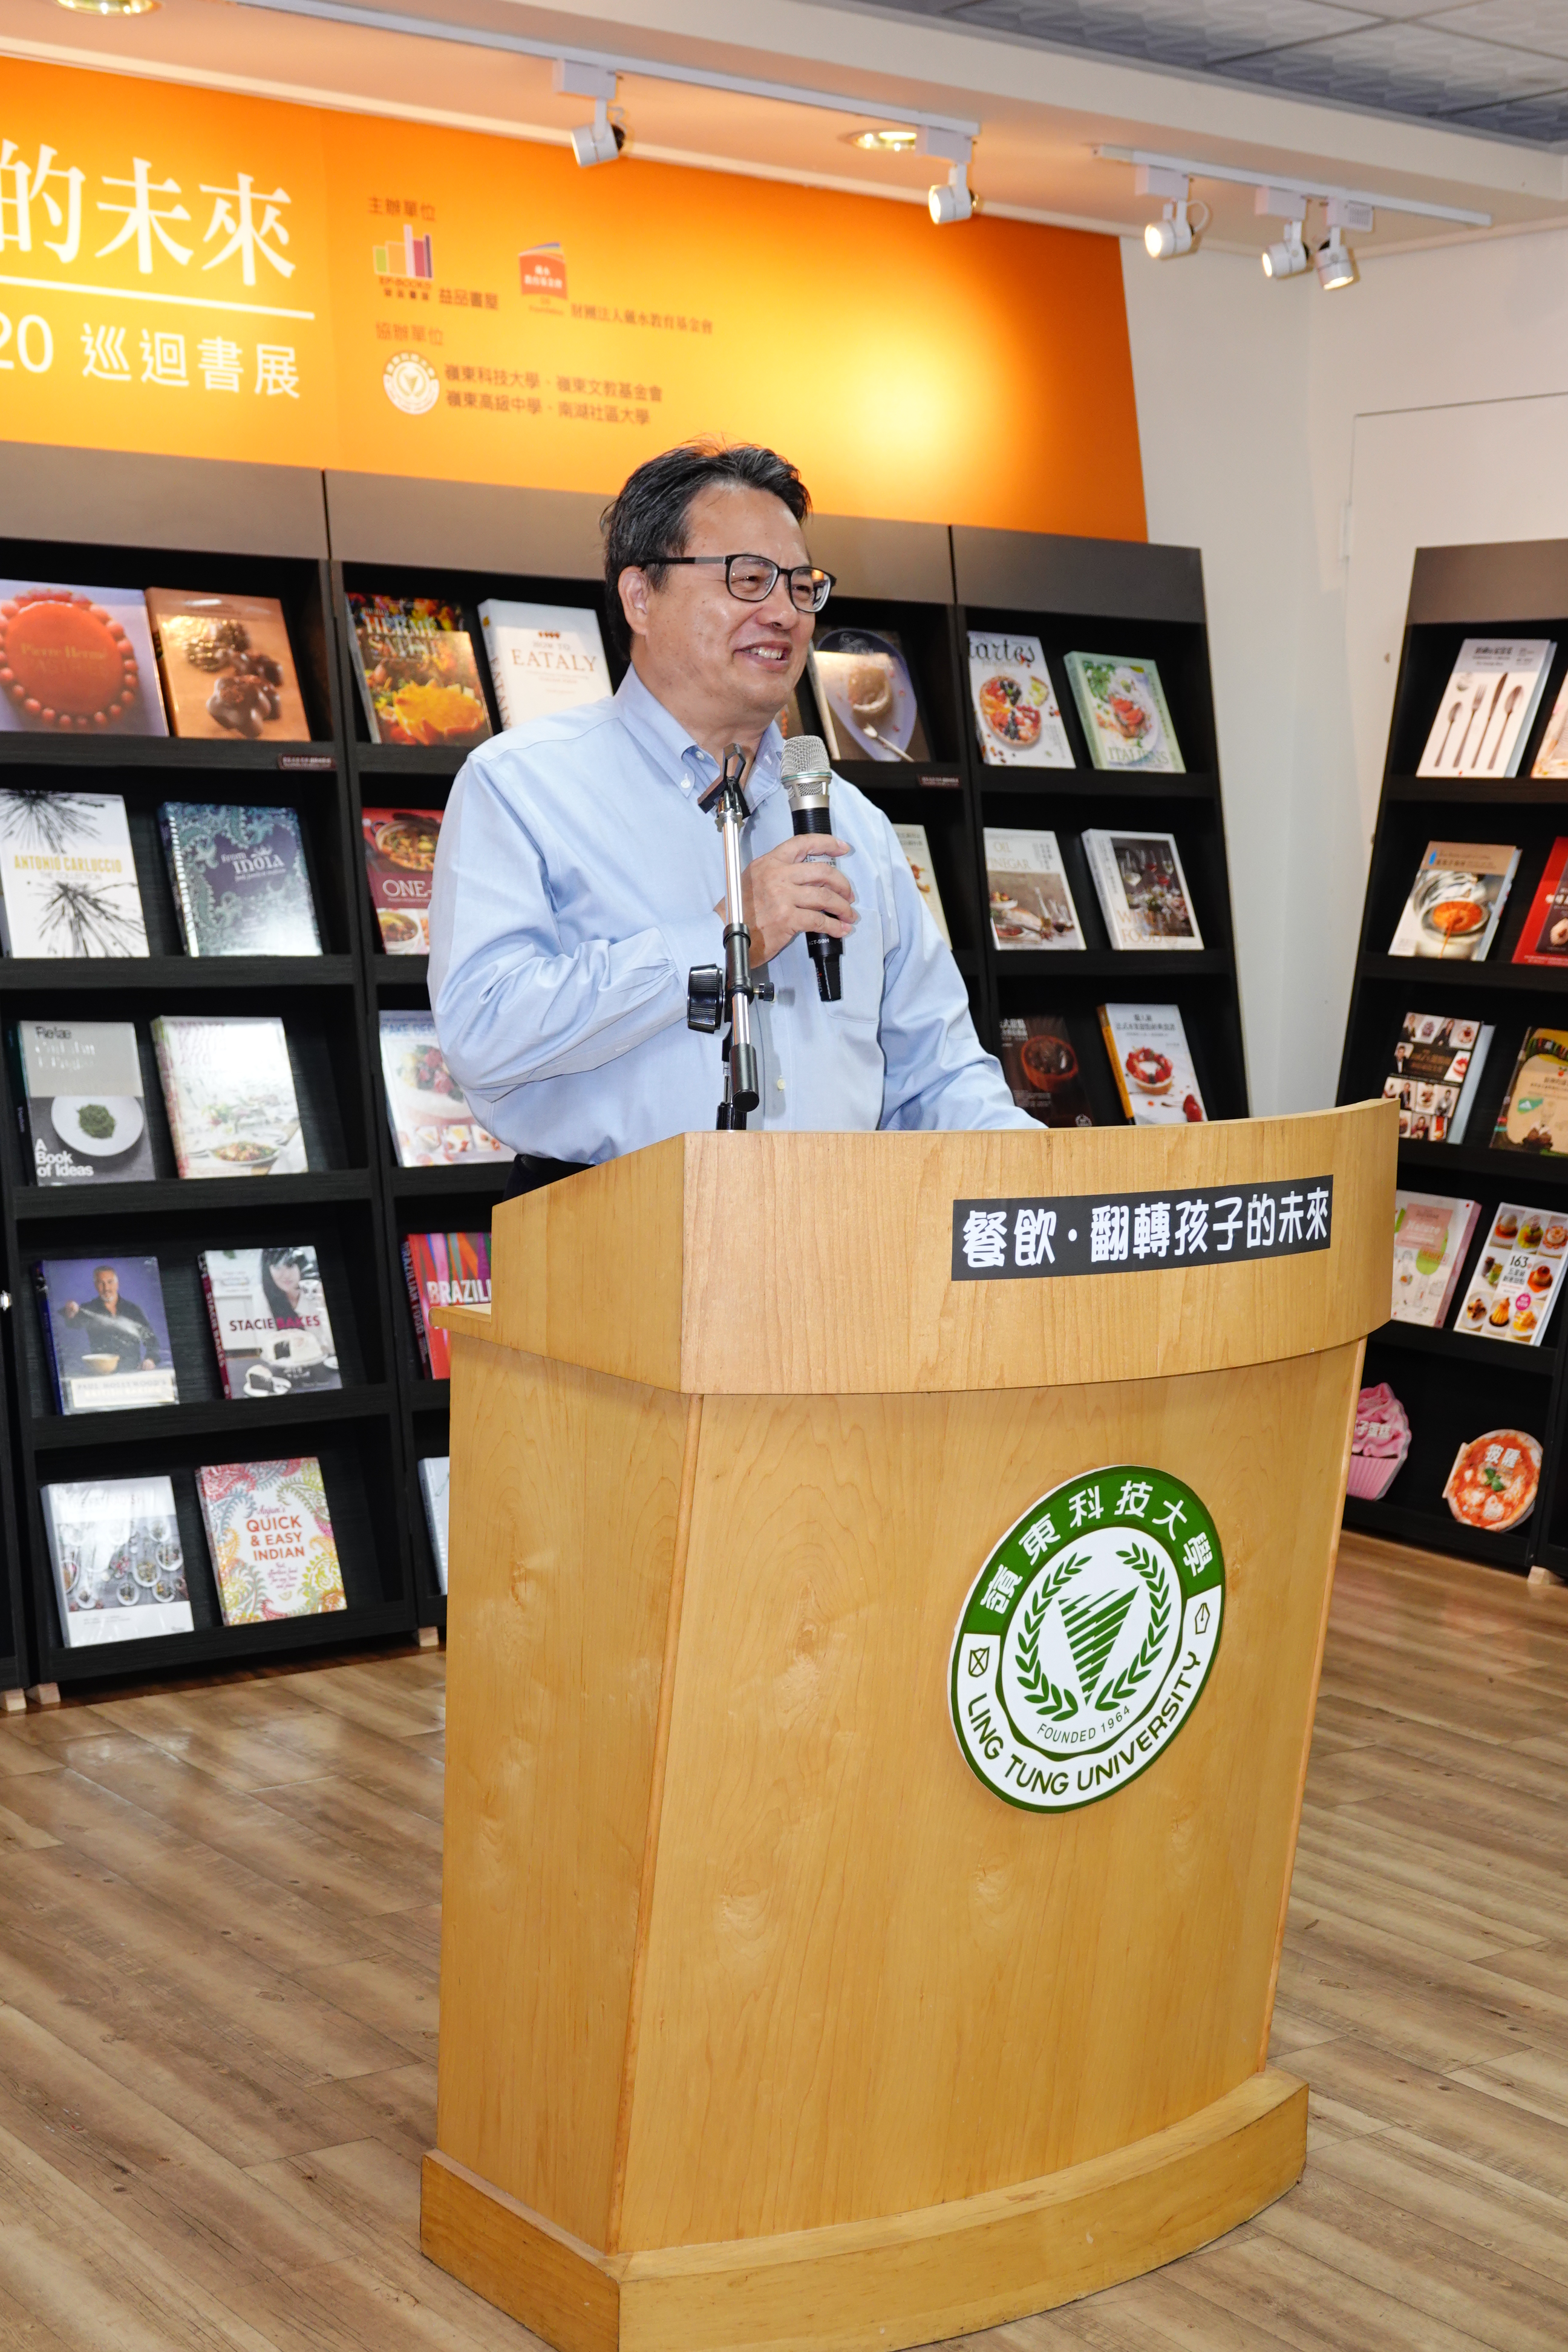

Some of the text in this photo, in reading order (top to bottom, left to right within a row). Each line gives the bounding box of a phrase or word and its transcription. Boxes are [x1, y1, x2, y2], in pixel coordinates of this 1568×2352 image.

[0, 138, 296, 286] 的未來
[80, 322, 299, 399] 巡迴書展
[511, 648, 596, 672] EATALY
[14, 854, 122, 873] ANTONIO CARLUCCIO
[382, 878, 433, 897] ONE-
[1122, 927, 1166, 944] FOOD
[34, 1138, 47, 1152] A
[35, 1149, 73, 1165] Book
[37, 1163, 94, 1177] of Ideas
[1510, 1255, 1530, 1268] 163
[229, 1315, 321, 1331] STACIE BAKES
[1356, 1420, 1392, 1439] 子蛋糕
[246, 1515, 302, 1532] QUICK
[251, 1532, 302, 1546] & EASY
[980, 1480, 1213, 1615] 嶺東科技大學
[253, 1546, 305, 1561] INDIAN
[968, 1651, 1201, 1795] LING TUNG UNIVERSITY
[1037, 1705, 1131, 1744] FOUNDED 1964
